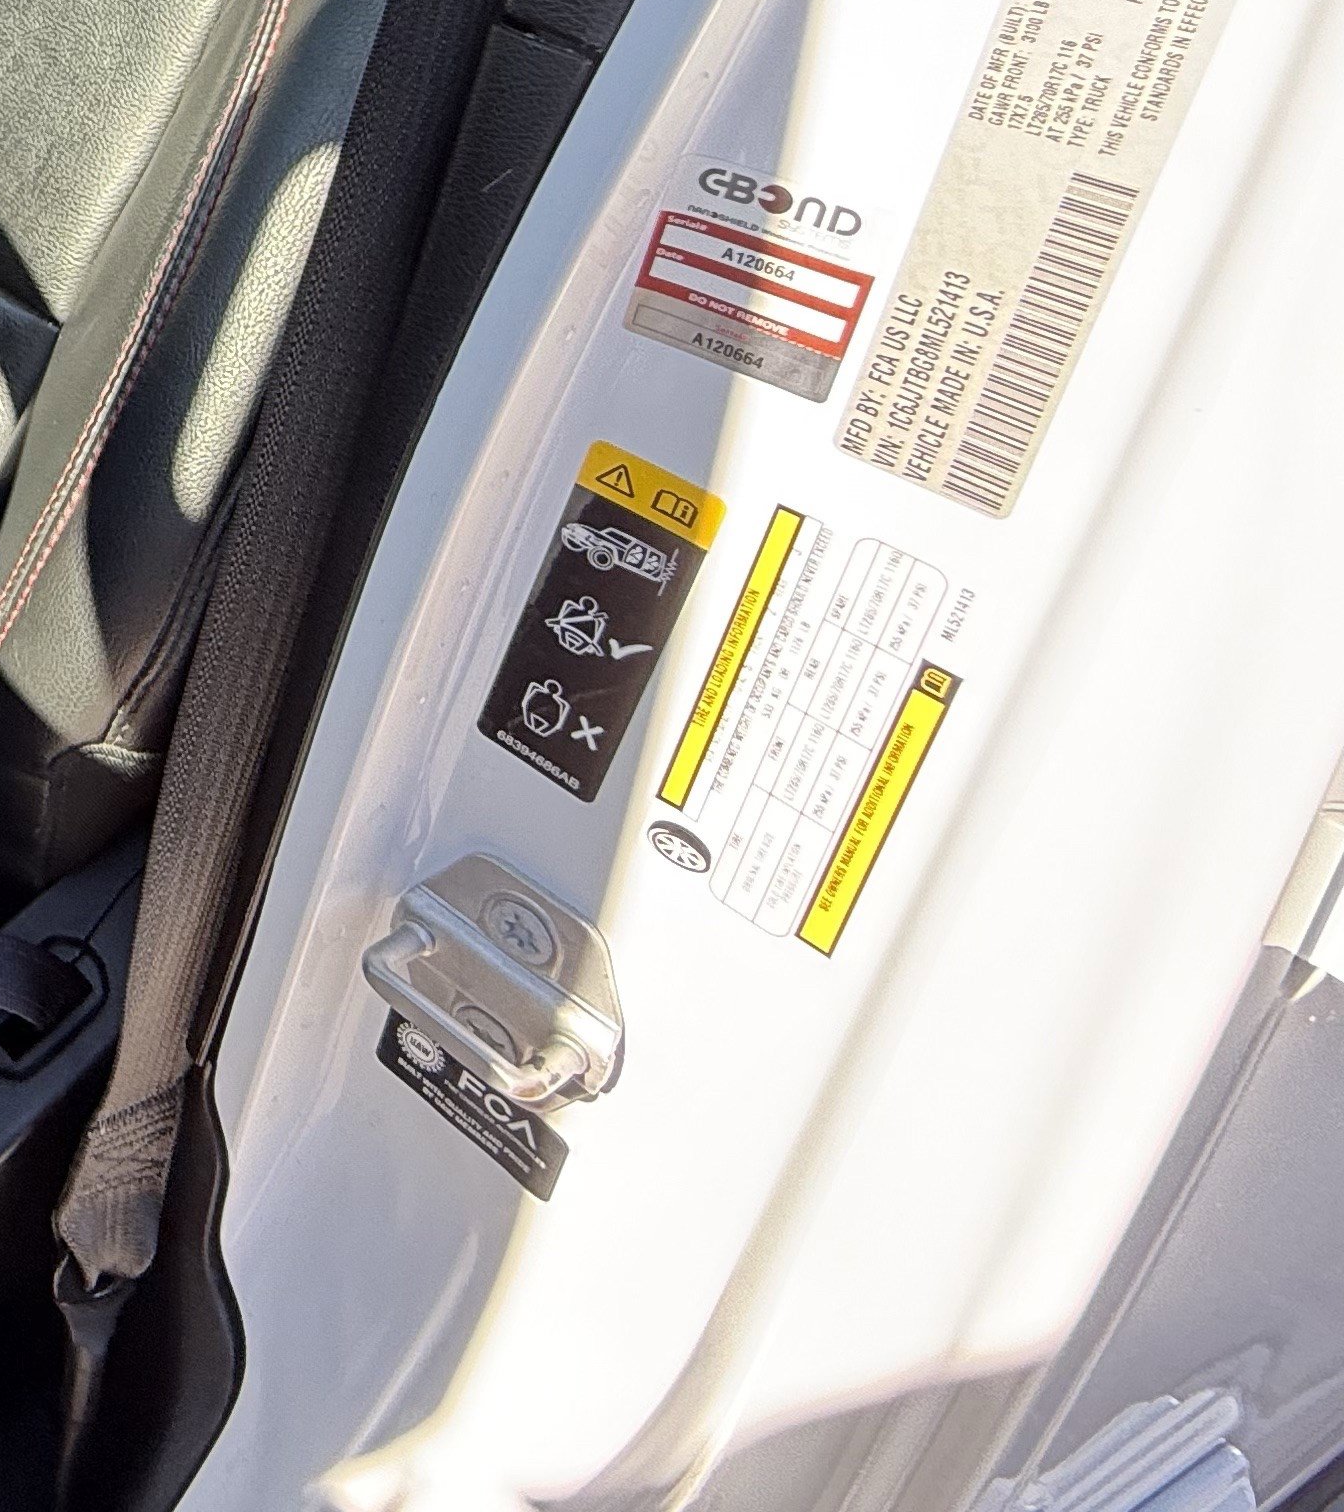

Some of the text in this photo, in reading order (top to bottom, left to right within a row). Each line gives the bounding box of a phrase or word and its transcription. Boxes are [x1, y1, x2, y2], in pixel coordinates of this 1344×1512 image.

[1031, 0, 1049, 13] LB
[1020, 16, 1043, 42] 3100
[1081, 31, 1103, 51] PSI
[1130, 15, 1173, 79] CONFORMS
[986, 47, 1009, 72] MFR
[1075, 52, 1093, 67] 37
[1140, 51, 1185, 120] STANDARDS
[1170, 36, 1191, 48] IN
[980, 74, 998, 90] OF
[1026, 60, 1068, 136] LT285/70R17C
[1056, 39, 1077, 58] 116
[1061, 80, 1082, 102] kPa
[968, 91, 992, 120] DATE
[987, 91, 1013, 125] GAWR
[1007, 93, 1033, 130] 17X7.5
[1052, 103, 1073, 124] 255
[1066, 74, 1112, 147] TYPE: TRUCK
[1109, 82, 1144, 128] VEHICLE
[1045, 126, 1063, 143] AT
[1097, 130, 1124, 157] THIS
[722, 247, 796, 283] A120664
[687, 292, 708, 307] DO
[707, 299, 735, 317] NOT
[735, 309, 790, 337] REMOVE
[691, 330, 764, 371] A120664
[869, 269, 971, 469] VIN: 1C6JJTBG8ML521413
[840, 293, 923, 455] MFD BY: FCA US LLC
[901, 289, 1005, 481] VEHICLE MADE IN: U.S.A.
[725, 587, 760, 649] INFORMATION
[942, 587, 976, 643] ML521413
[708, 648, 734, 688] LOADING
[700, 686, 718, 707] AND
[692, 705, 710, 727] TIRE
[837, 834, 861, 867] MANUAL
[851, 817, 869, 836] FOR
[860, 774, 889, 820] ADDITIONAL
[879, 720, 914, 776] INFORMATION
[444, 1097, 483, 1130] QUALITY
[482, 1129, 503, 1148] AND
[456, 1069, 536, 1151] FCA
